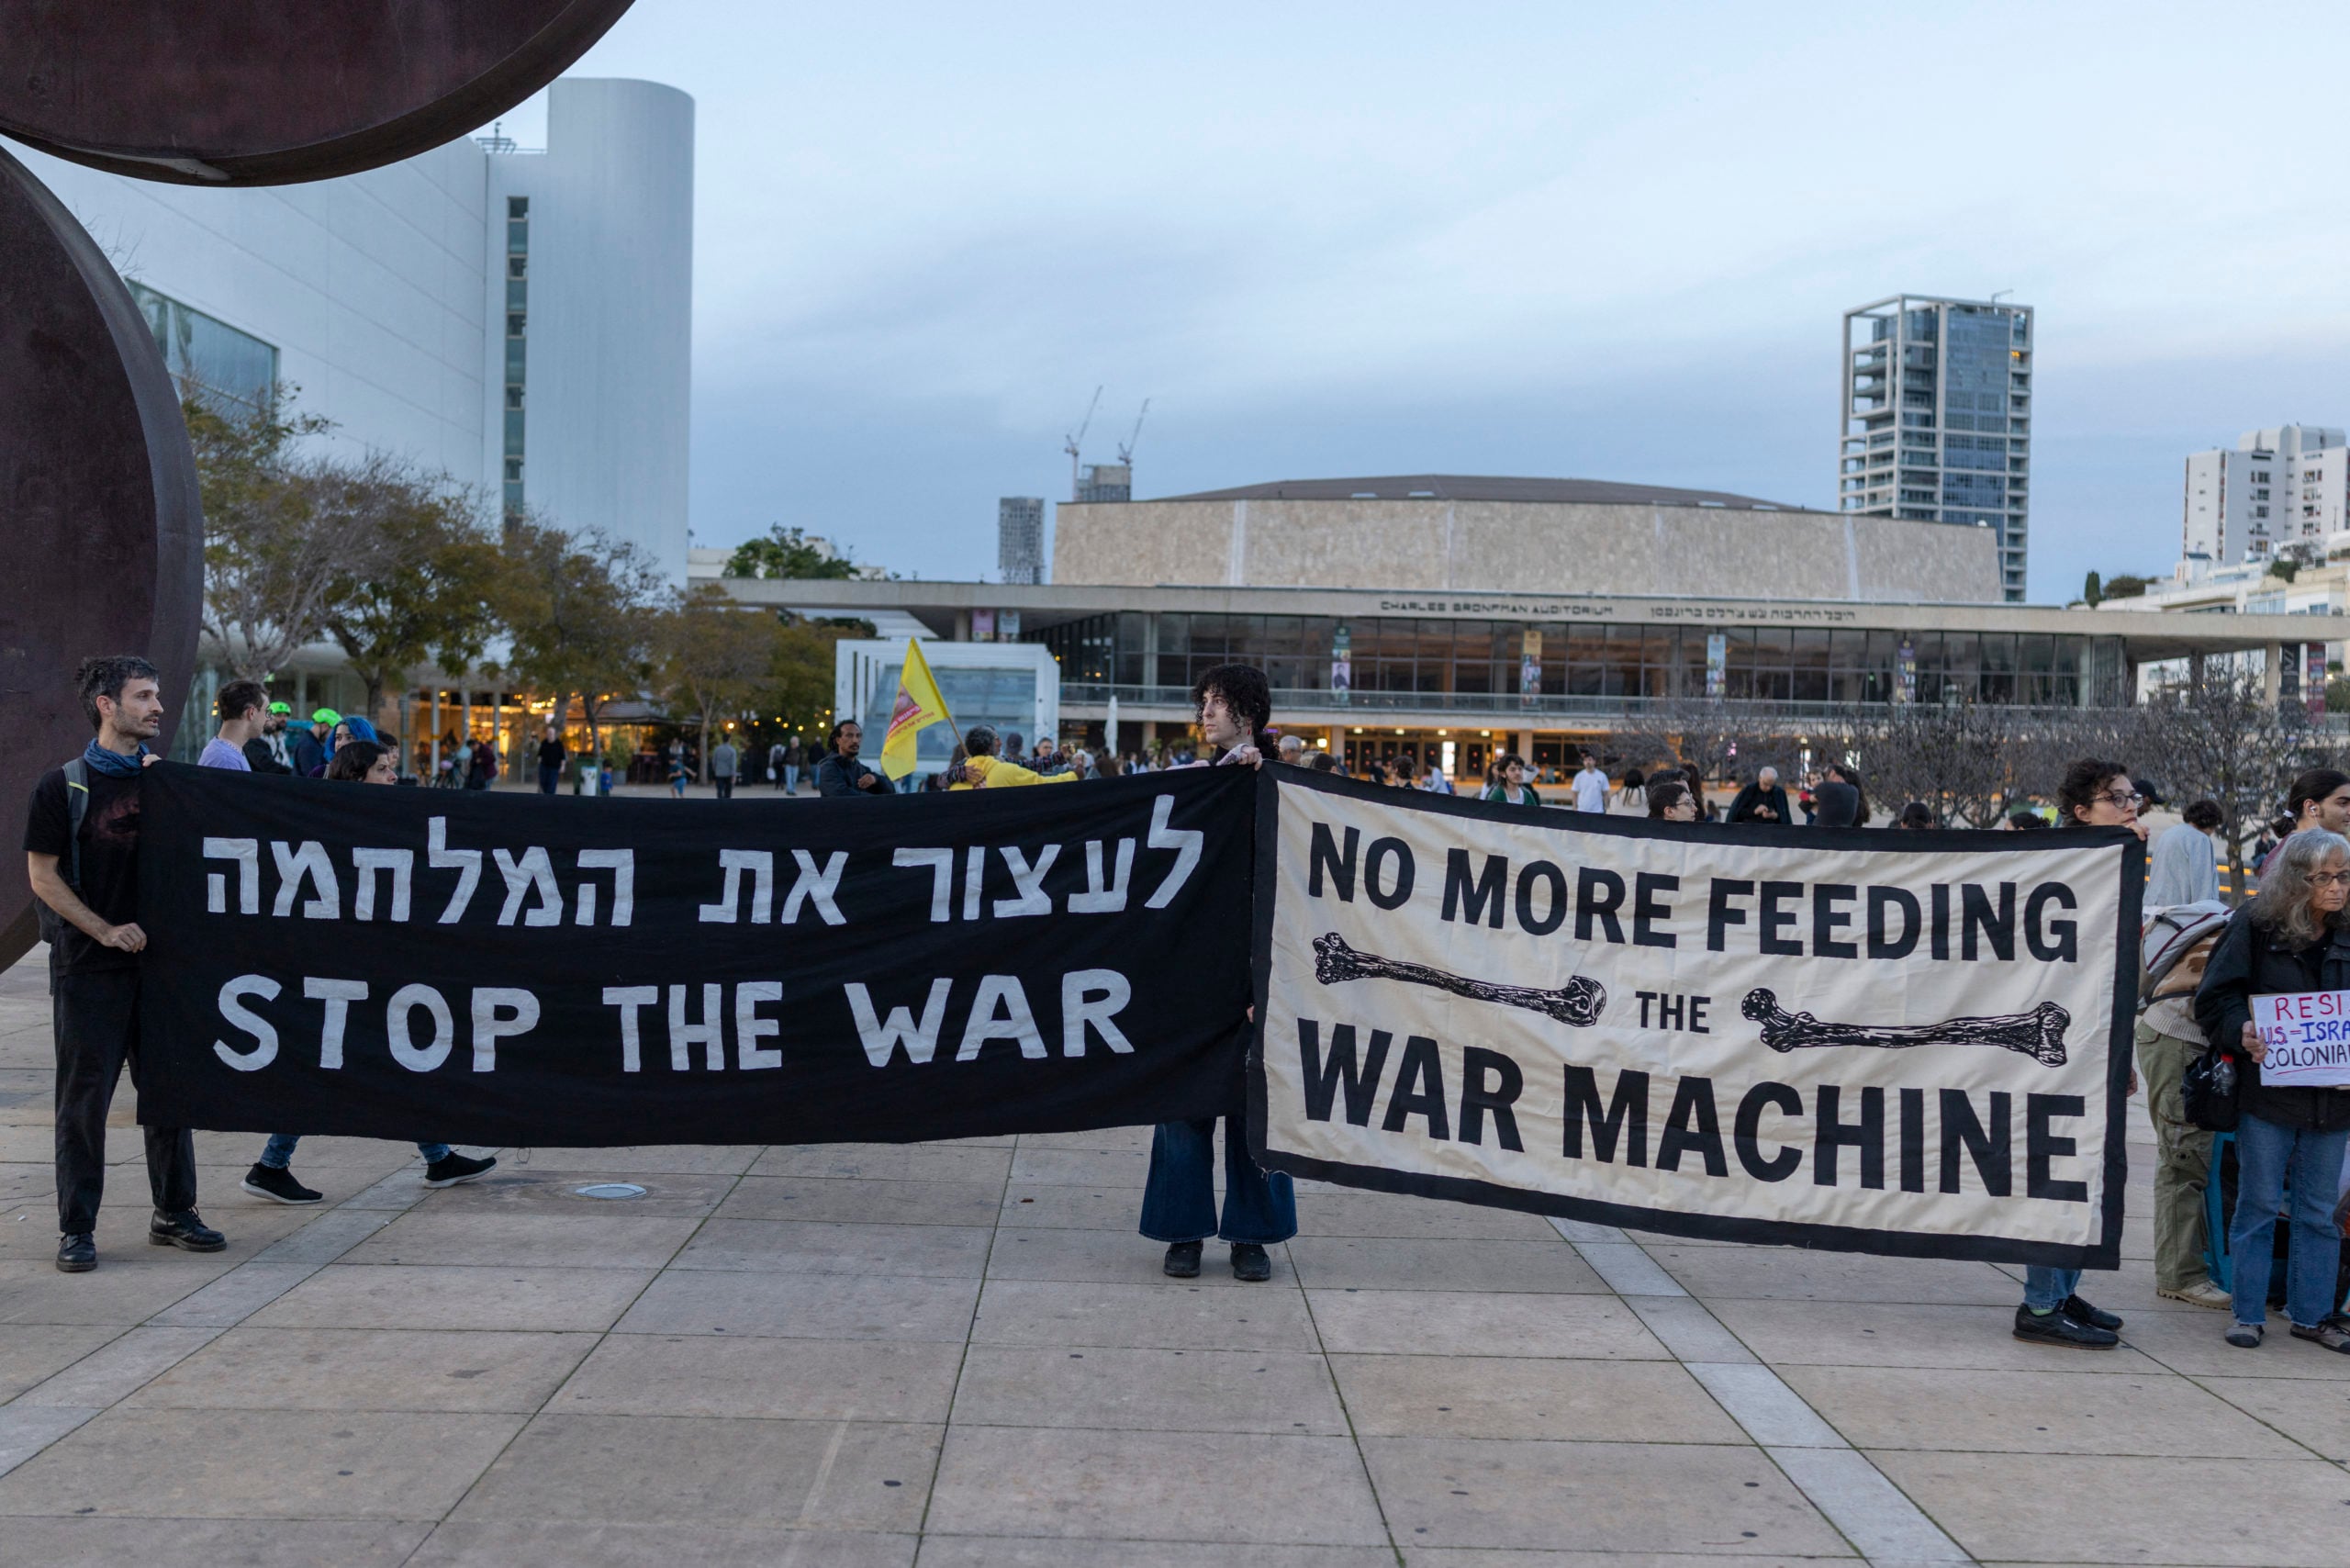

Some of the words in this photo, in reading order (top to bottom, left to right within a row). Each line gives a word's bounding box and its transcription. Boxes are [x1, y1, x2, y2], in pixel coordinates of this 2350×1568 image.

[1381, 600, 1446, 612] CHARLES
[1453, 602, 1528, 613] BRONFMAN
[1533, 604, 1613, 616] AUDITORIUM
[203, 817, 634, 927] המלחמה
[699, 848, 849, 925] את
[892, 795, 1204, 922] לעצור
[1308, 823, 1416, 912] NO
[1441, 847, 1680, 949] MORE
[1707, 877, 2077, 963] FEEDING
[213, 975, 541, 1072] STOP
[602, 981, 783, 1072] THE
[845, 969, 1135, 1068] WAR
[1636, 991, 1711, 1035] THE
[2275, 993, 2350, 1021] RESI
[2262, 1045, 2350, 1070] COLONIA
[1297, 1017, 1525, 1153] WAR
[1562, 1063, 2088, 1204] MACHINE
